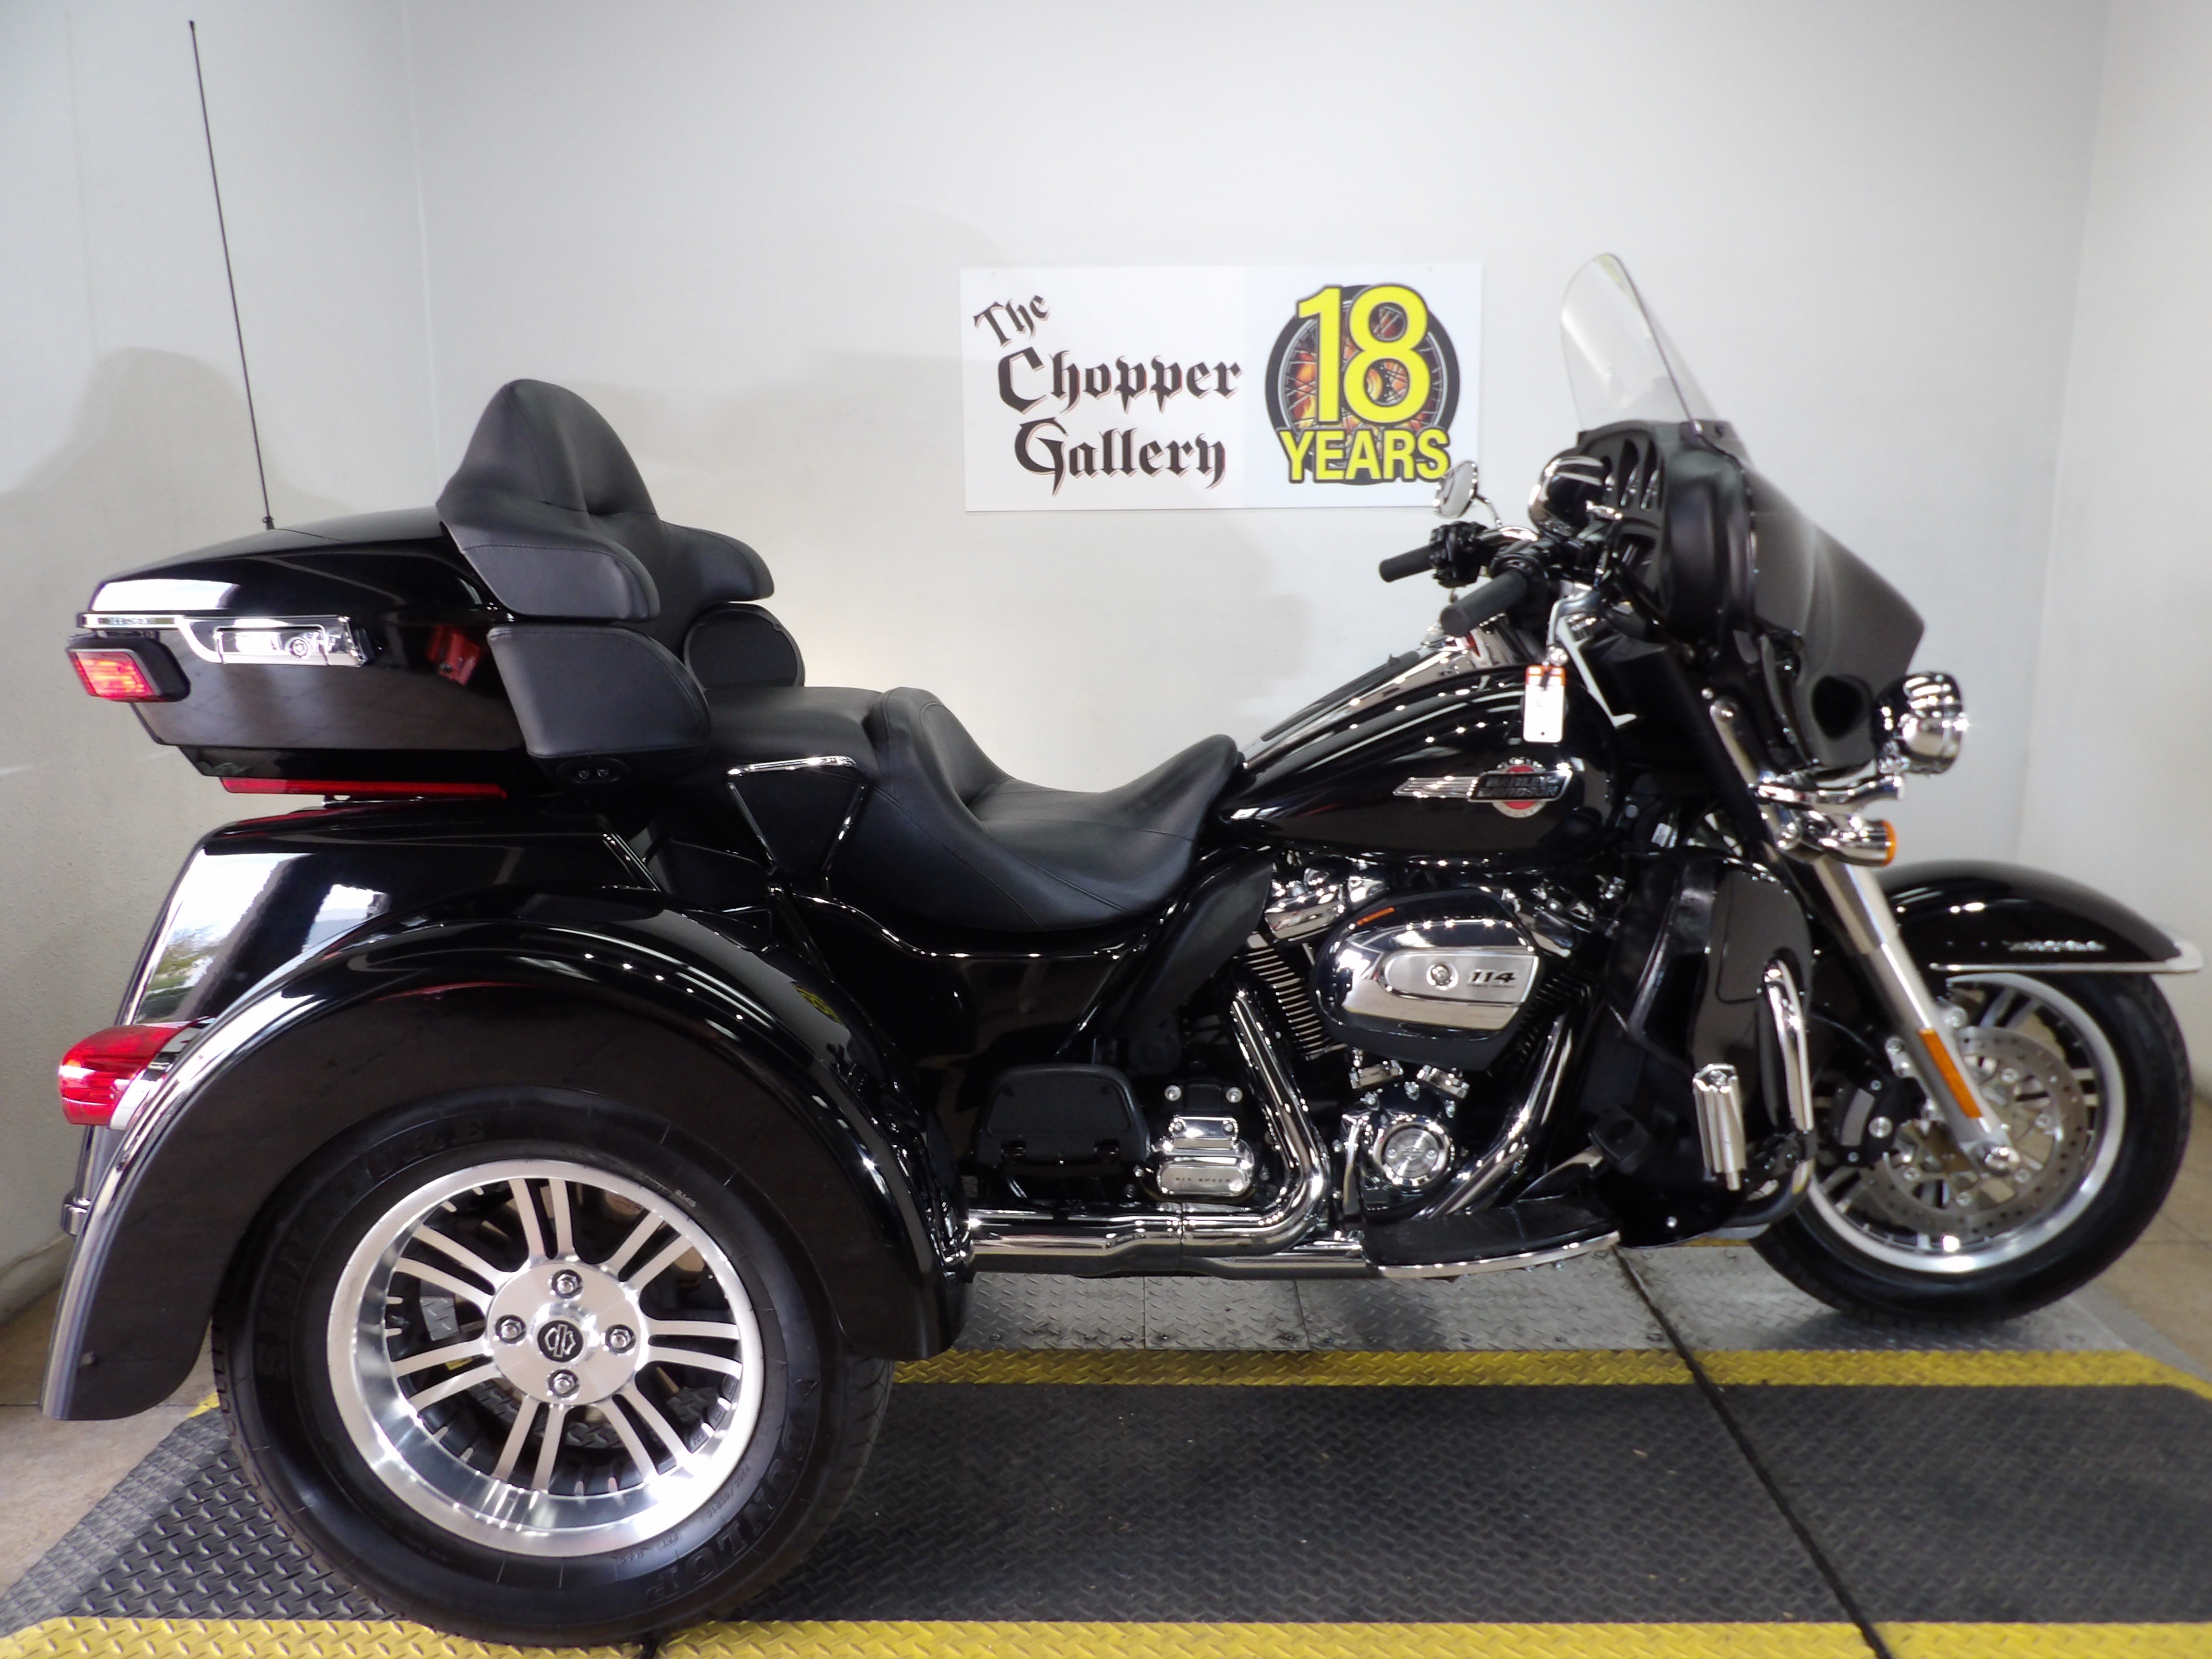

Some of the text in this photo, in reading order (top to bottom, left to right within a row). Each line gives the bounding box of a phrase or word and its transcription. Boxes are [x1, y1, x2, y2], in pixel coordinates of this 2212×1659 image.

[973, 294, 1050, 346] The
[1298, 285, 1431, 422] 18
[998, 347, 1242, 414] Chopper
[1014, 417, 1225, 496] Gallery
[1281, 430, 1448, 479] YEARS
[1471, 971, 1516, 983] 114
[645, 1416, 809, 1604] DUNLOP
